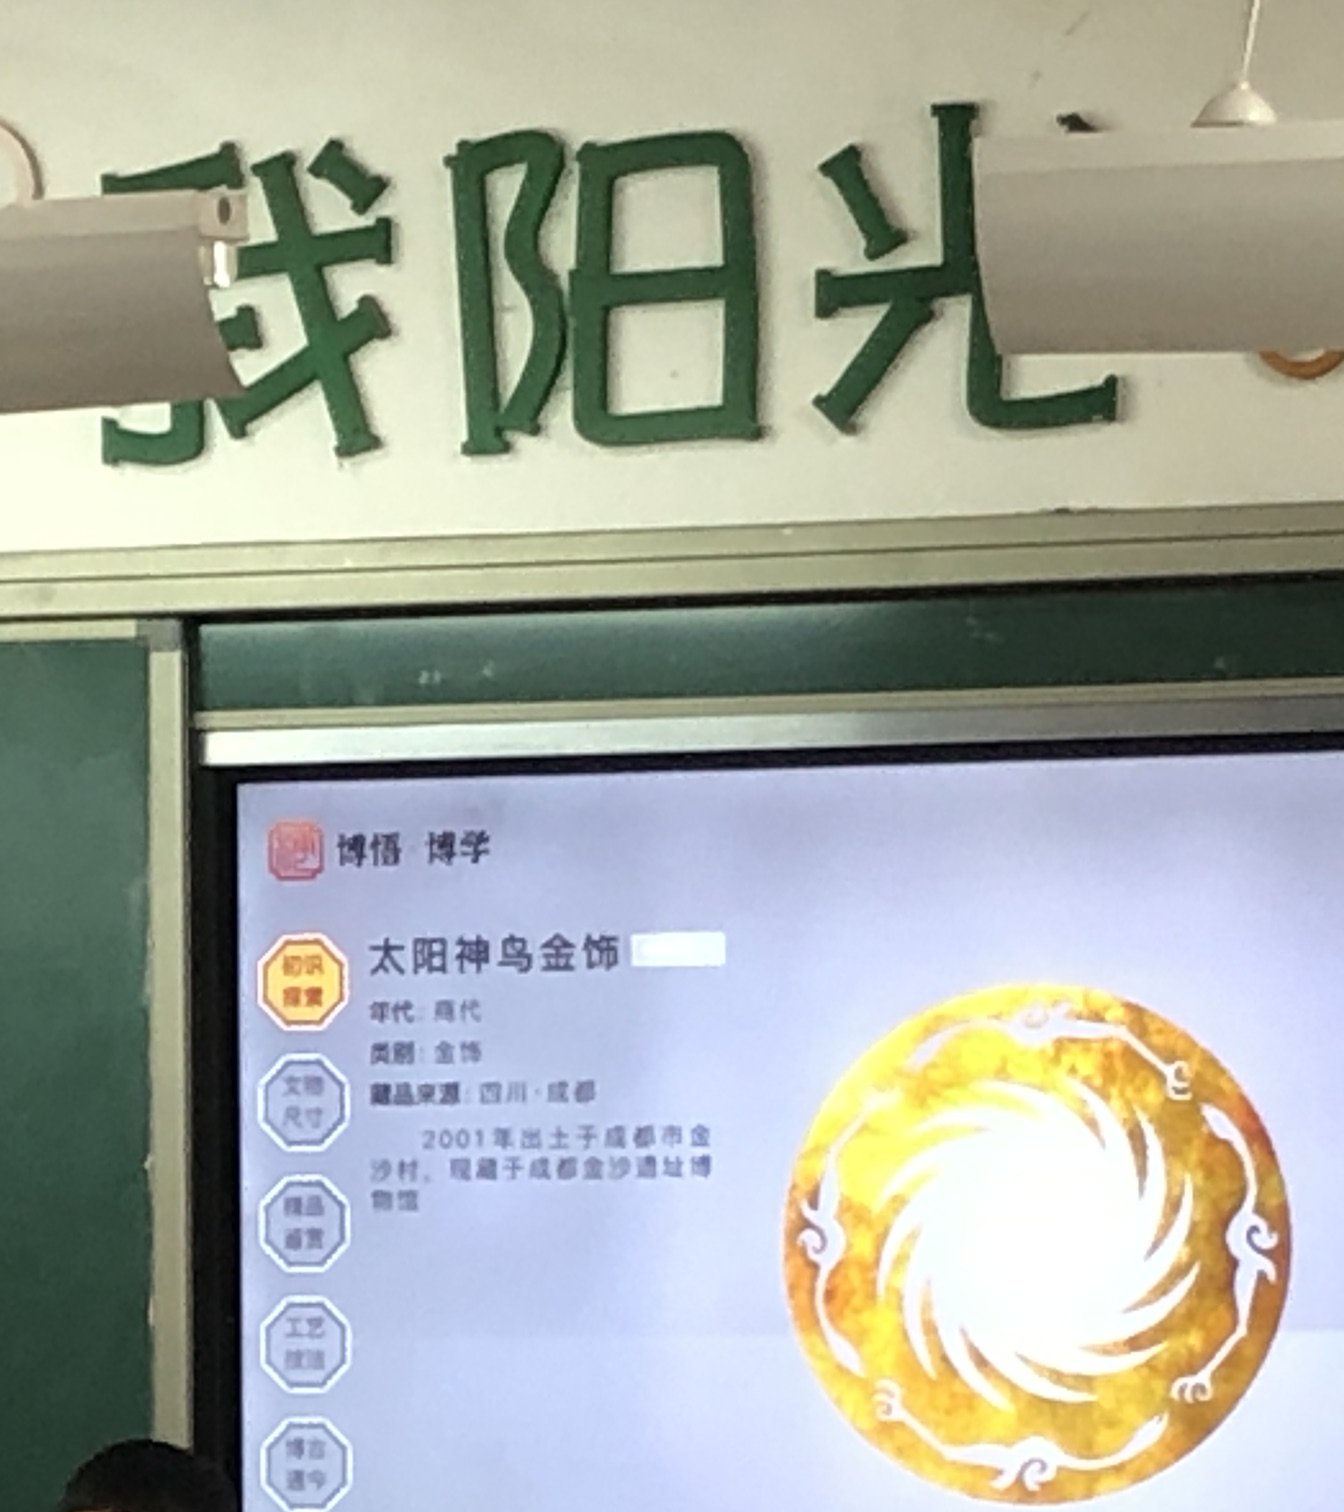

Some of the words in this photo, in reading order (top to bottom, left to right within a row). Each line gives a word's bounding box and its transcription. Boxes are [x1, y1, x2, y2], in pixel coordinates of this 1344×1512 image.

[425, 829, 491, 866] 博学
[368, 932, 620, 976] 太阳神鸟金饰
